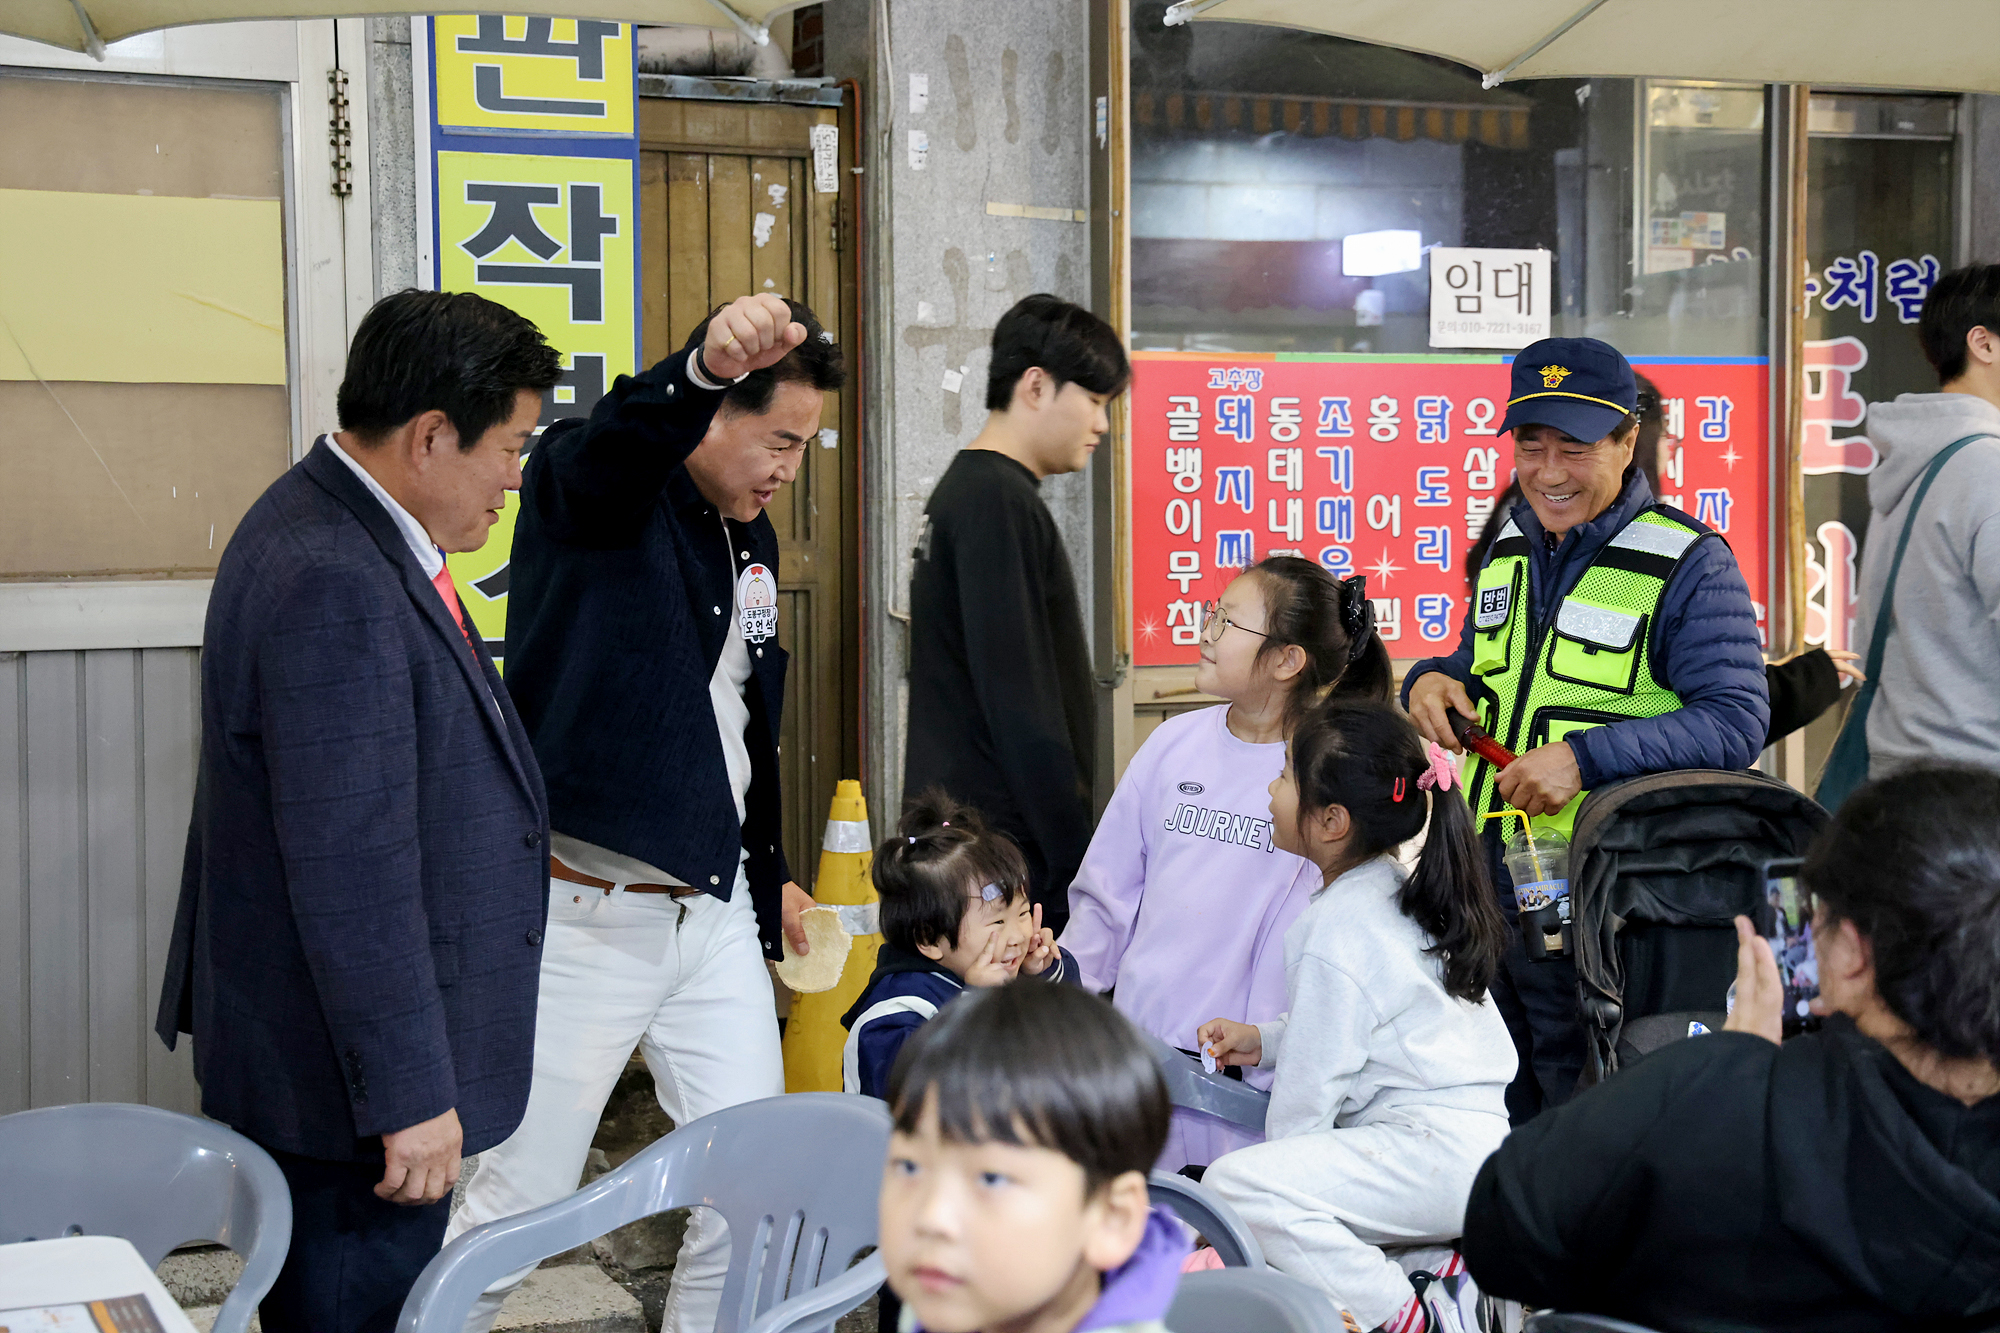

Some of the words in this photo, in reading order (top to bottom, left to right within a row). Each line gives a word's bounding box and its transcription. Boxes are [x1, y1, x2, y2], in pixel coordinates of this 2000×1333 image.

[1446, 260, 1532, 316] 임대
[1804, 250, 1940, 324] 처럼
[1208, 367, 1264, 392] 고추장
[1268, 396, 1304, 558] 동태내
[1165, 395, 1203, 646] 골뱅이무침
[1414, 395, 1455, 643] 닭도리탕
[747, 608, 772, 619] 도봉구청장
[1484, 587, 1507, 613] 방범
[745, 618, 773, 634] 오언석
[1536, 883, 1565, 892] MIRACLE
